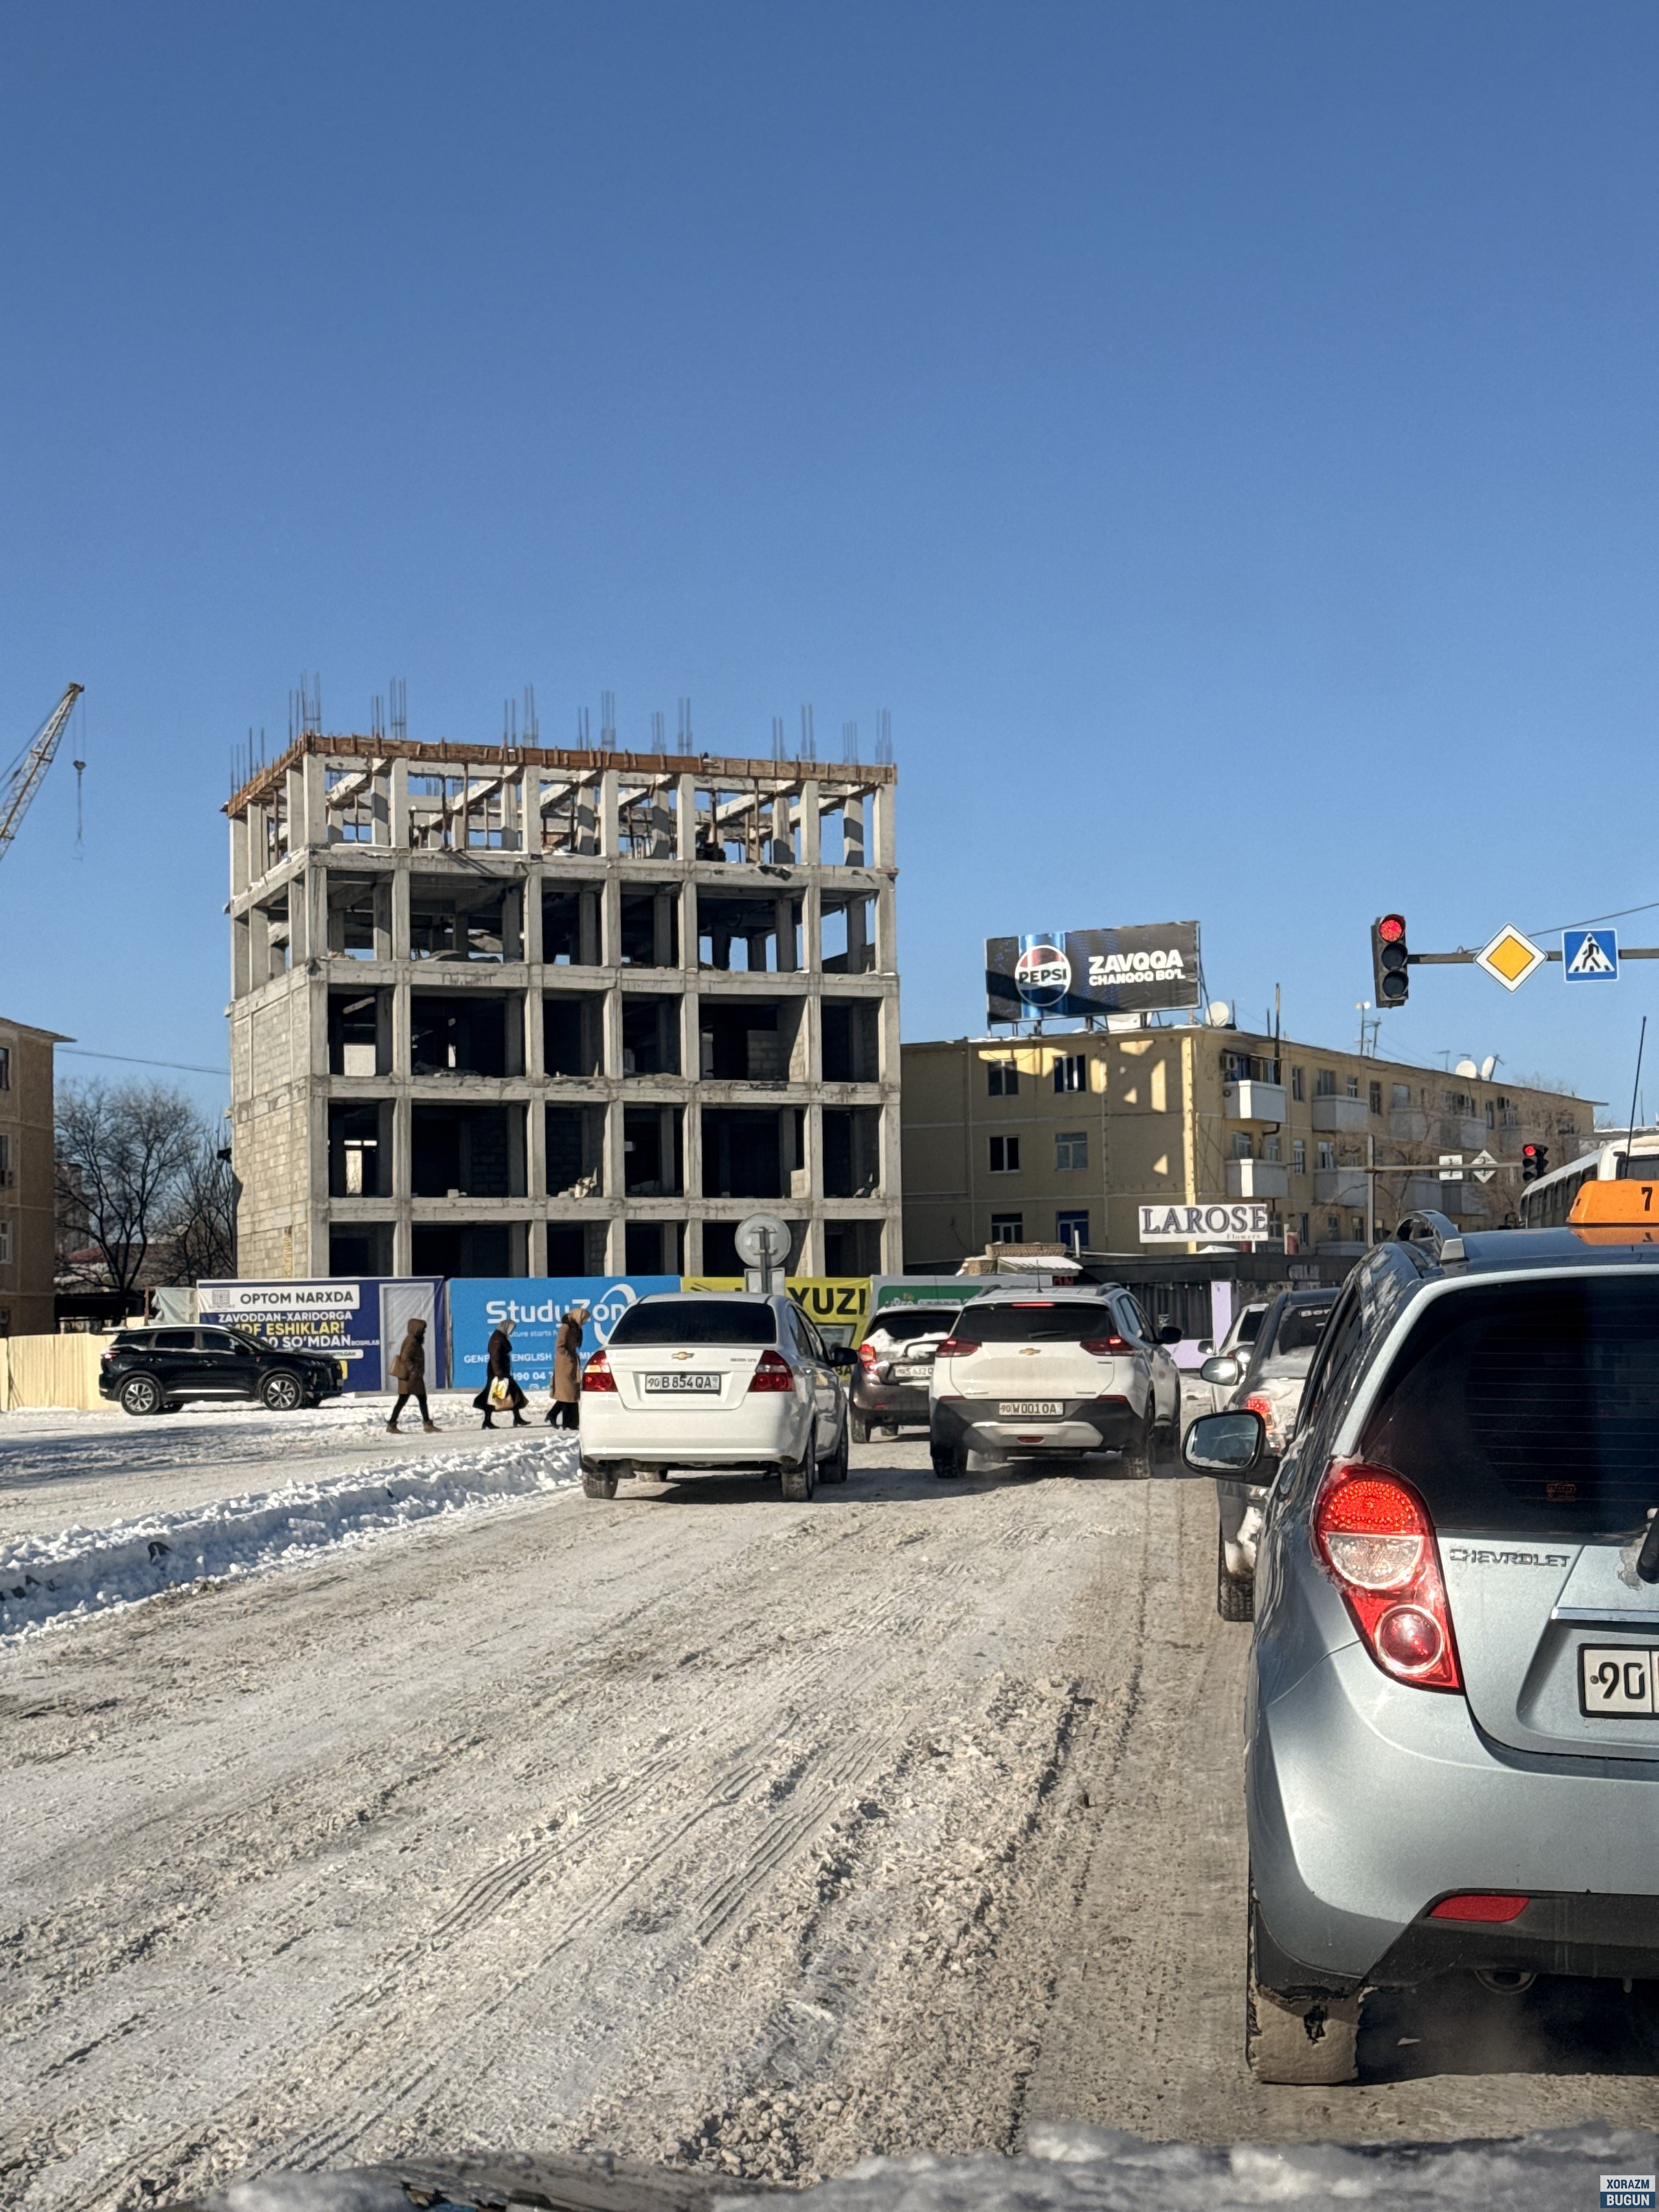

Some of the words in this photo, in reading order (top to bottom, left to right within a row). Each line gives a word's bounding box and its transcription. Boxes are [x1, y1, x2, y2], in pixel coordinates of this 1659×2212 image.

[1088, 950, 1184, 974] ZAVQQA
[1019, 968, 1066, 984] PEPSI
[1088, 970, 1154, 986] CHANQOQ
[1155, 969, 1186, 981] BO'L
[1641, 1187, 1653, 1211] 7
[1142, 1206, 1267, 1233] LAROSE
[240, 1293, 291, 1305] OPTOM
[296, 1291, 354, 1304] NARXDA
[787, 1287, 866, 1315] YUZI
[218, 1311, 353, 1323] ZAVODDAN-XARIDORGA
[486, 1299, 626, 1328] StudyZon
[266, 1322, 345, 1335] ESHIKLAR!
[282, 1334, 351, 1348] SO'MDAN
[464, 1354, 490, 1364] GENE
[512, 1353, 551, 1362] ENGLISH
[648, 1378, 660, 1387] 90
[1001, 1404, 1011, 1413] 90
[1449, 1548, 1571, 1567] CHEVROLET
[1598, 1662, 1645, 1700] 90
